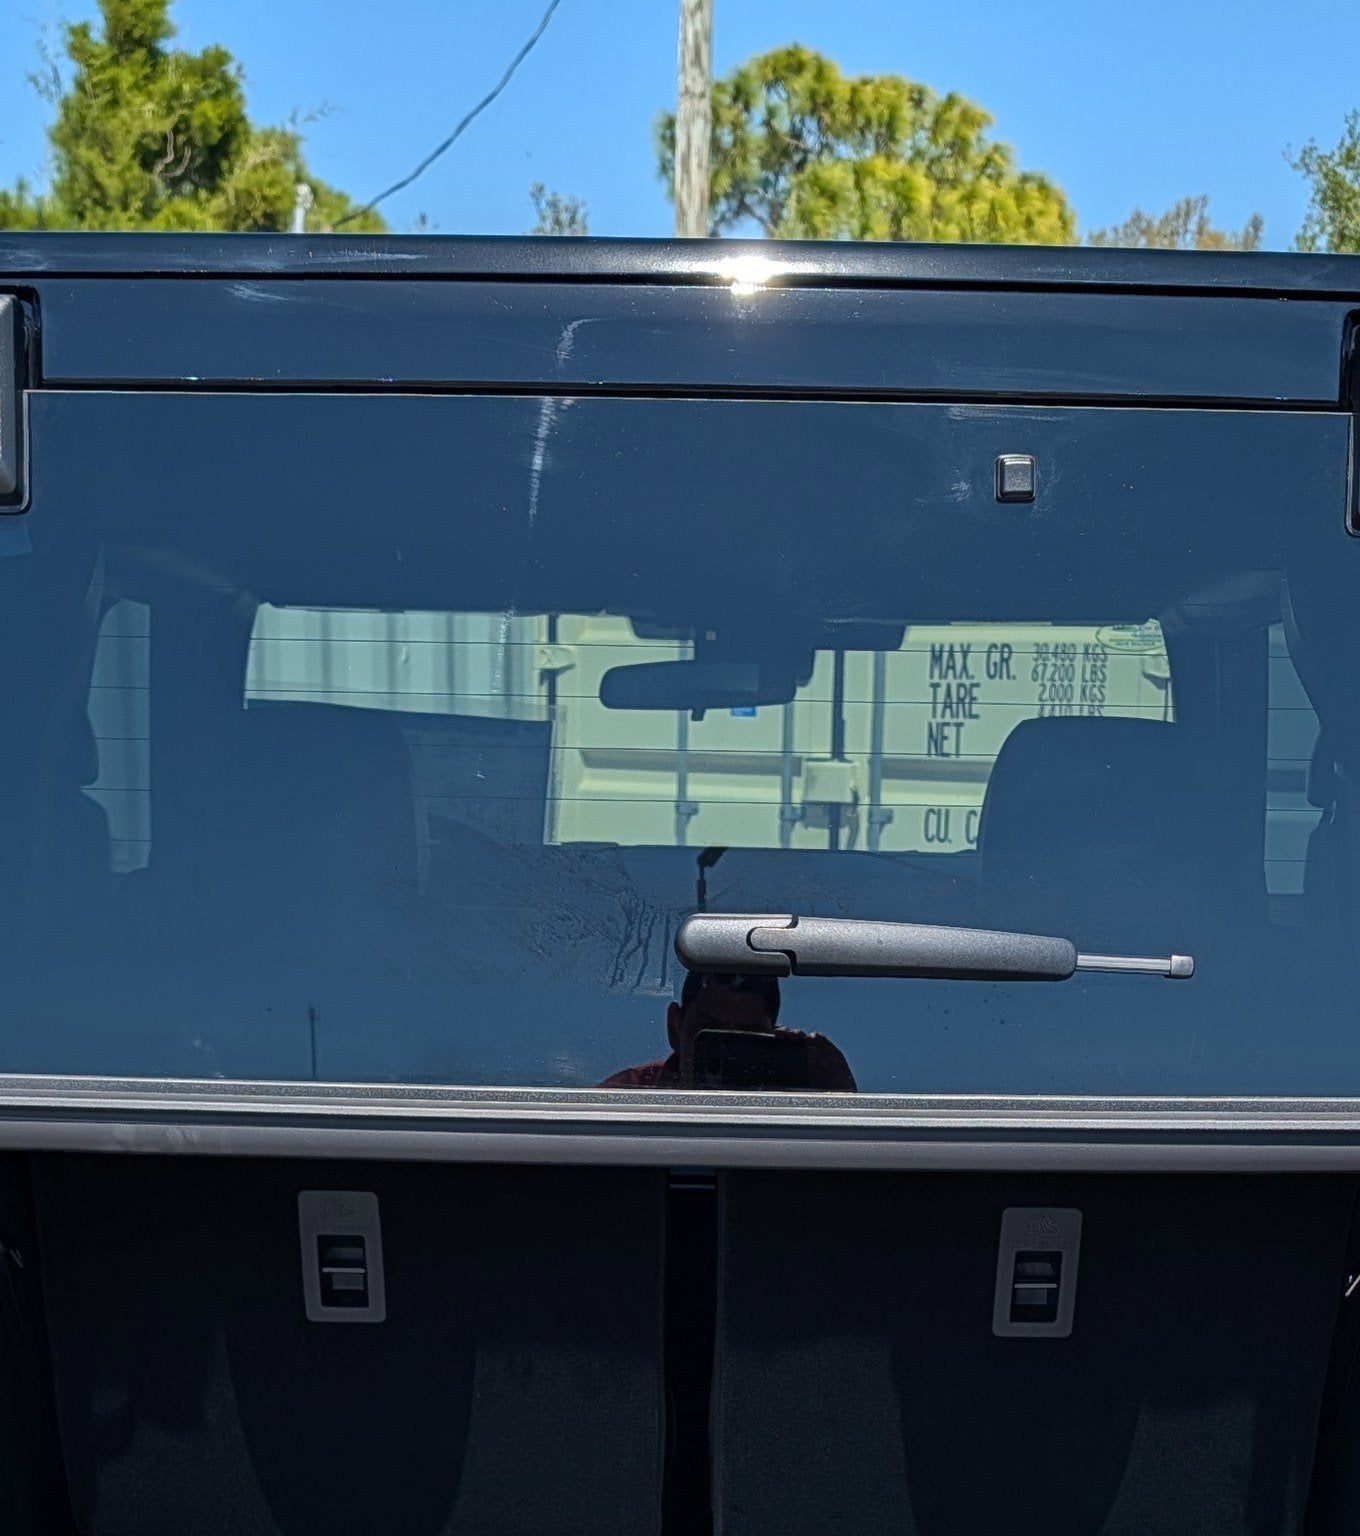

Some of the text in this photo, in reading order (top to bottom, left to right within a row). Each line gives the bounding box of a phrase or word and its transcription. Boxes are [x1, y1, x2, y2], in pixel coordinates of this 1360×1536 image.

[929, 643, 1017, 681] MAX. GR.
[1082, 643, 1108, 663] KGS
[1081, 664, 1107, 683] LBS
[929, 683, 981, 719] TARE
[1080, 683, 1106, 703] KGS
[927, 722, 966, 758] NET
[924, 808, 953, 843] CU.
